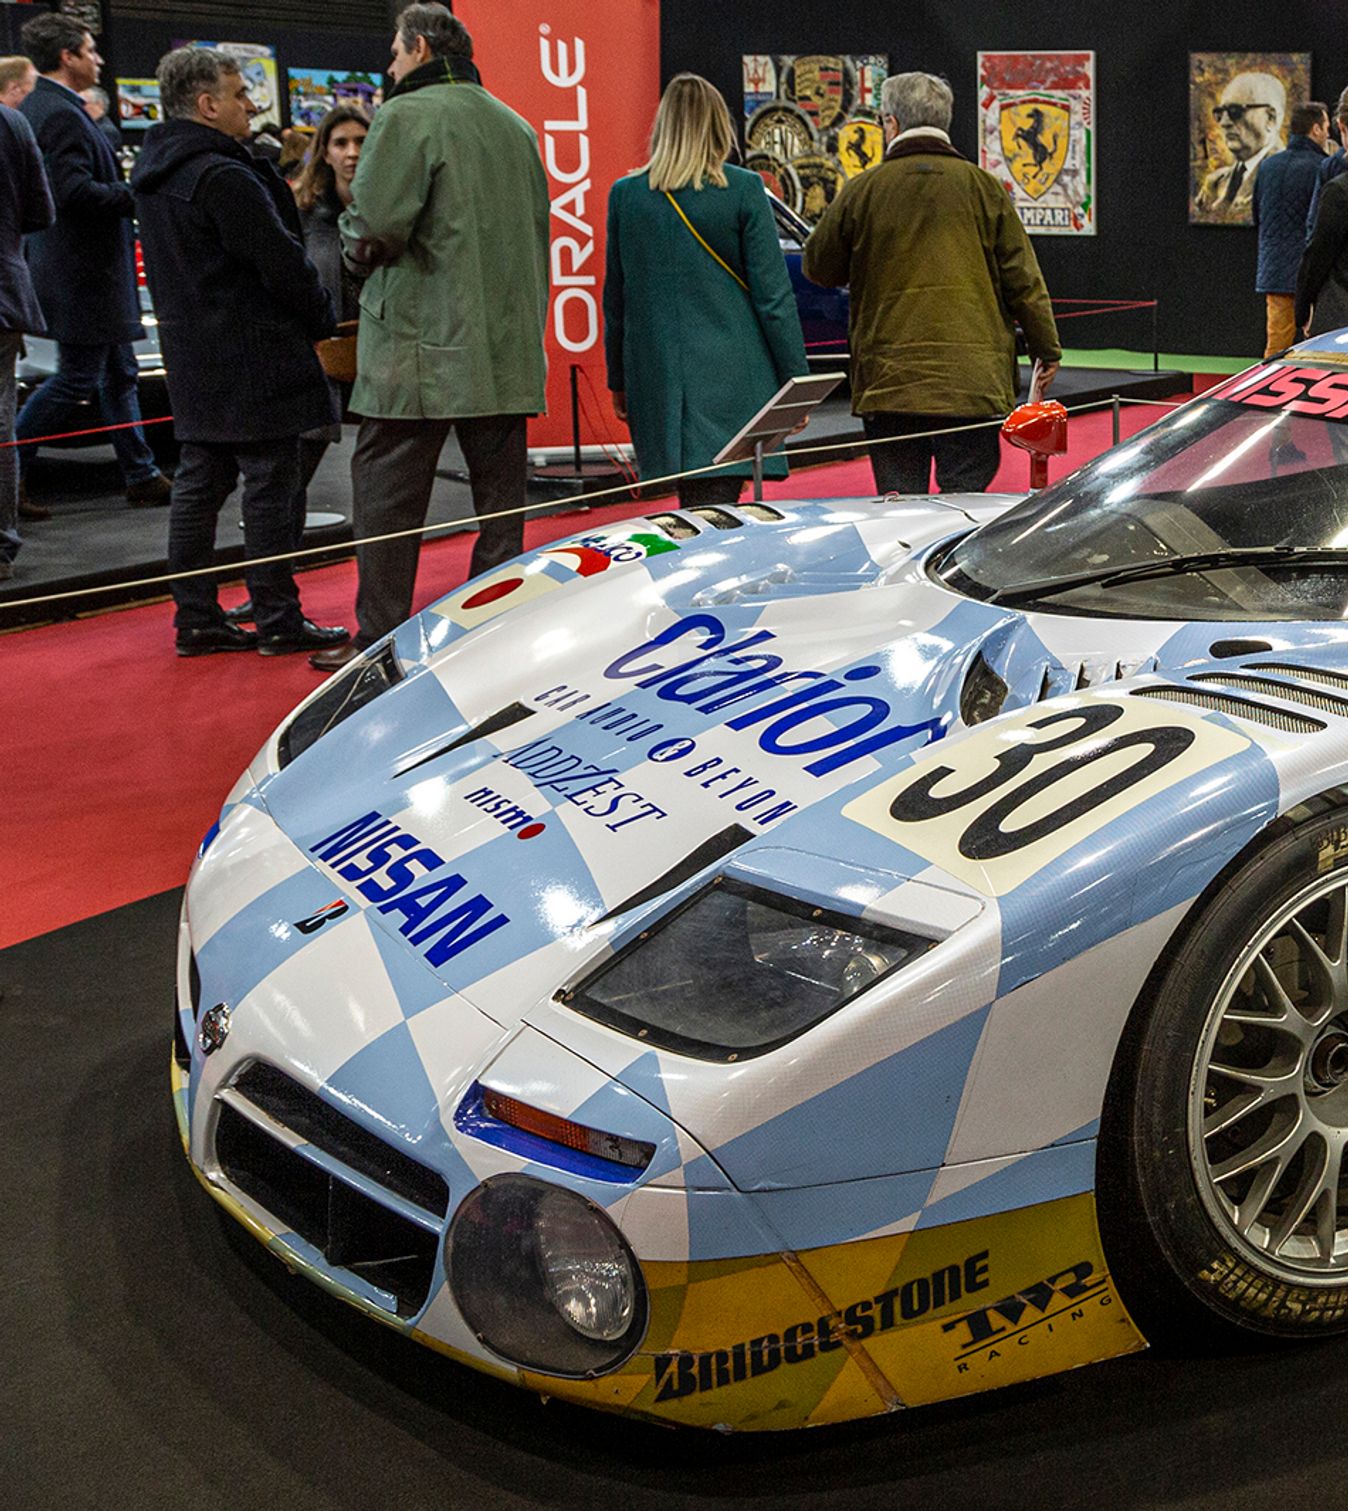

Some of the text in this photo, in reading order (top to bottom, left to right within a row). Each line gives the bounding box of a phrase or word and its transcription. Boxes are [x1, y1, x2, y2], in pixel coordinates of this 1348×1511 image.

[539, 36, 598, 352] ORACLE
[493, 735, 668, 833] ADDZEST
[533, 685, 592, 712] CAR
[576, 702, 665, 743] AUDIO
[684, 757, 798, 827] BEYON
[889, 703, 1196, 862] 30
[308, 810, 511, 969] NISSAN
[653, 1249, 991, 1403] BRIDGESTONE
[942, 1260, 1111, 1350] TWR
[957, 1296, 1113, 1374] RACING
